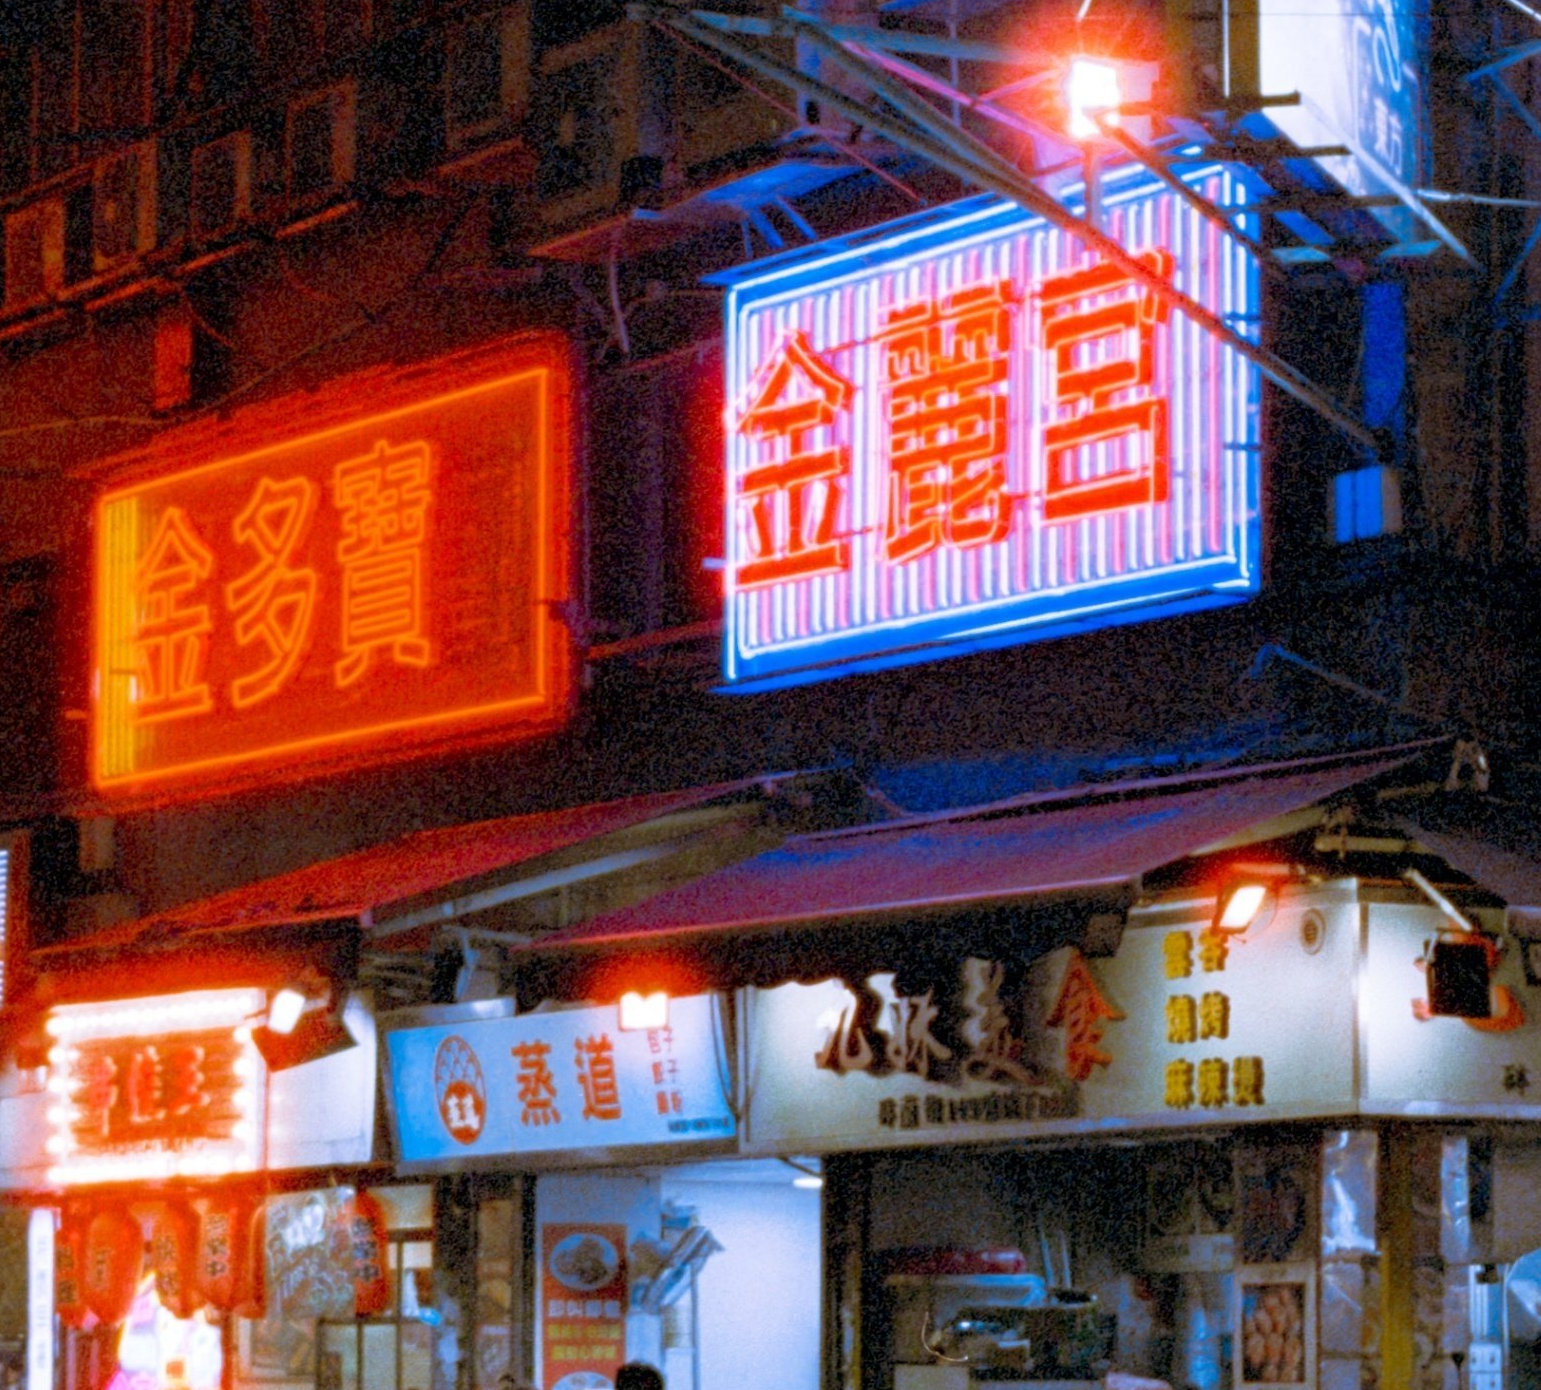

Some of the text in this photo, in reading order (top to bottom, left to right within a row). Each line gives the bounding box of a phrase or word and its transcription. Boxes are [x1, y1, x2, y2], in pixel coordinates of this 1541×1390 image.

[736, 247, 1175, 593] 金麗宮
[133, 440, 433, 726] 金多寶
[510, 1031, 624, 1127] 蒸道
